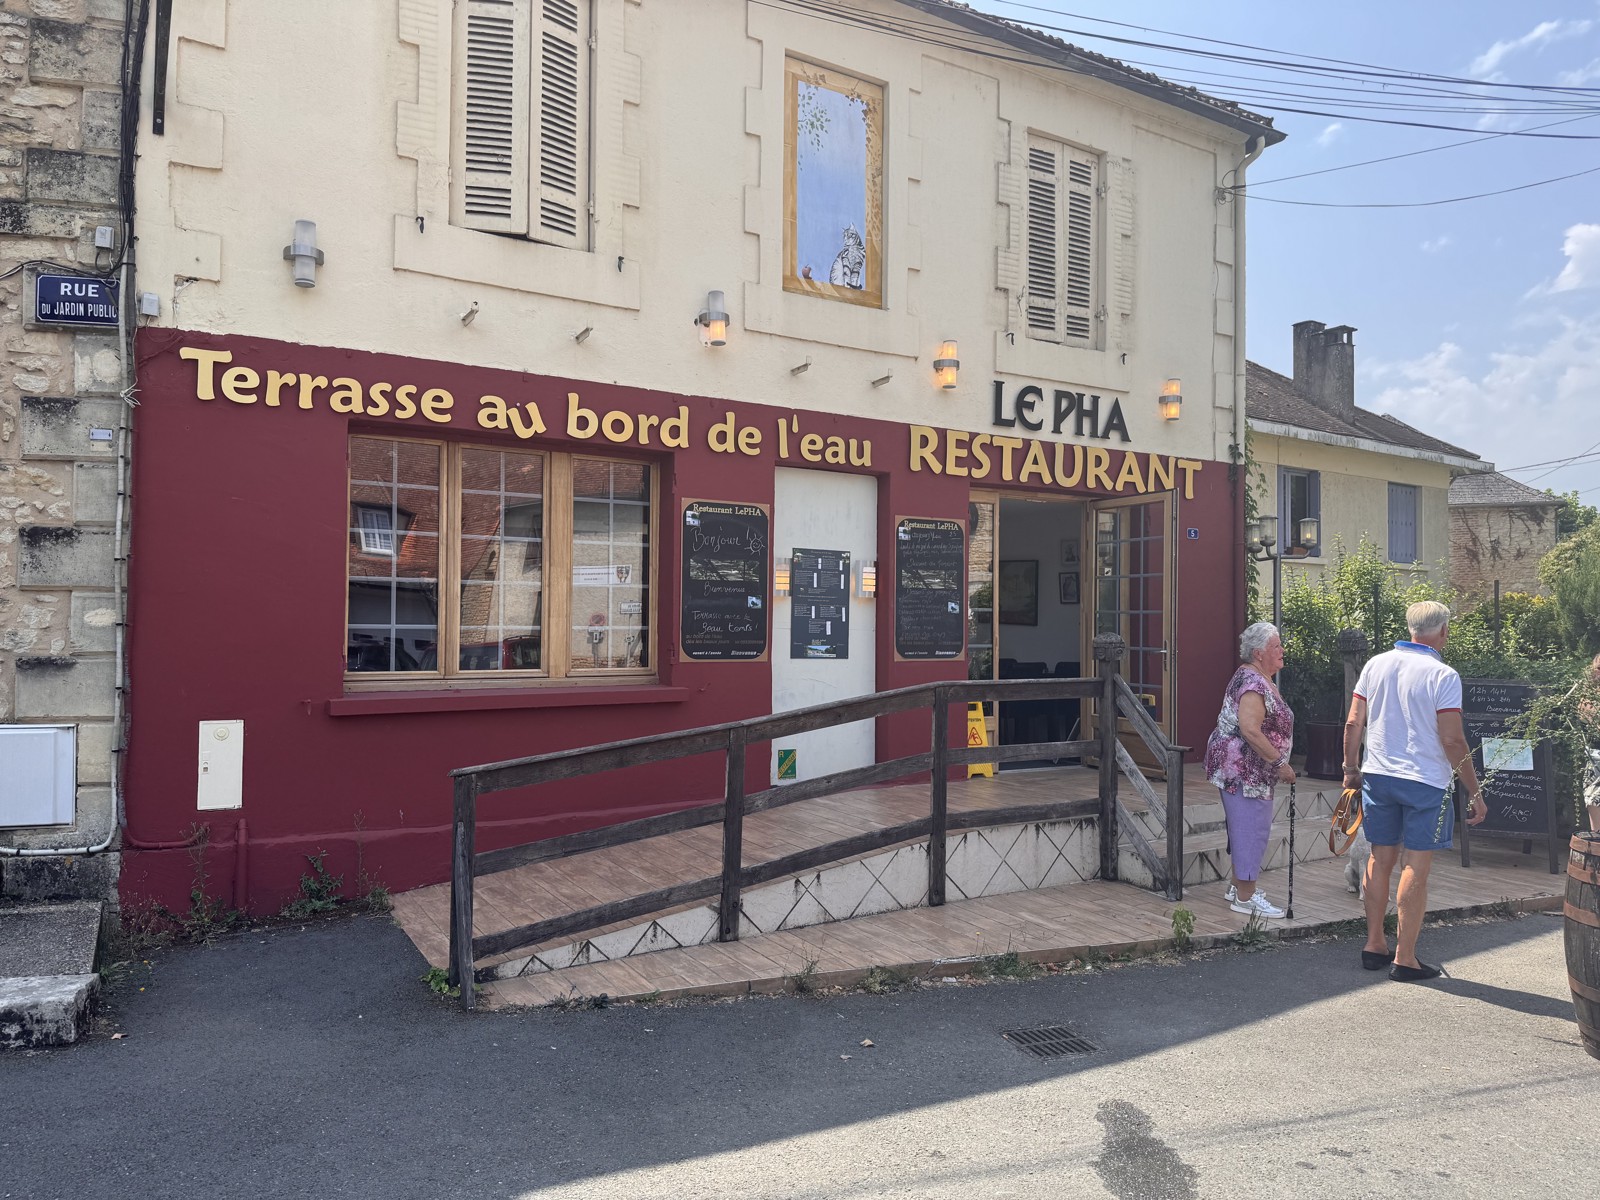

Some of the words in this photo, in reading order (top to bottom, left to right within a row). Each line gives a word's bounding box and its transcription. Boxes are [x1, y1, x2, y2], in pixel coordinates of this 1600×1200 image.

[60, 282, 99, 297] RUE
[41, 303, 51, 314] DU
[54, 302, 84, 316] JARDIN
[179, 346, 455, 423] Terrasse
[477, 395, 547, 439] au
[566, 392, 690, 448] bord
[707, 411, 762, 456] de
[777, 413, 872, 467] l'eau
[992, 380, 1044, 431] LE
[1051, 389, 1132, 443] PHA
[909, 424, 1203, 500] RESTAURANT
[693, 503, 733, 514] Restaurant
[735, 506, 762, 516] LePHA
[904, 520, 936, 530] Restaurant
[937, 522, 959, 531] LePHA
